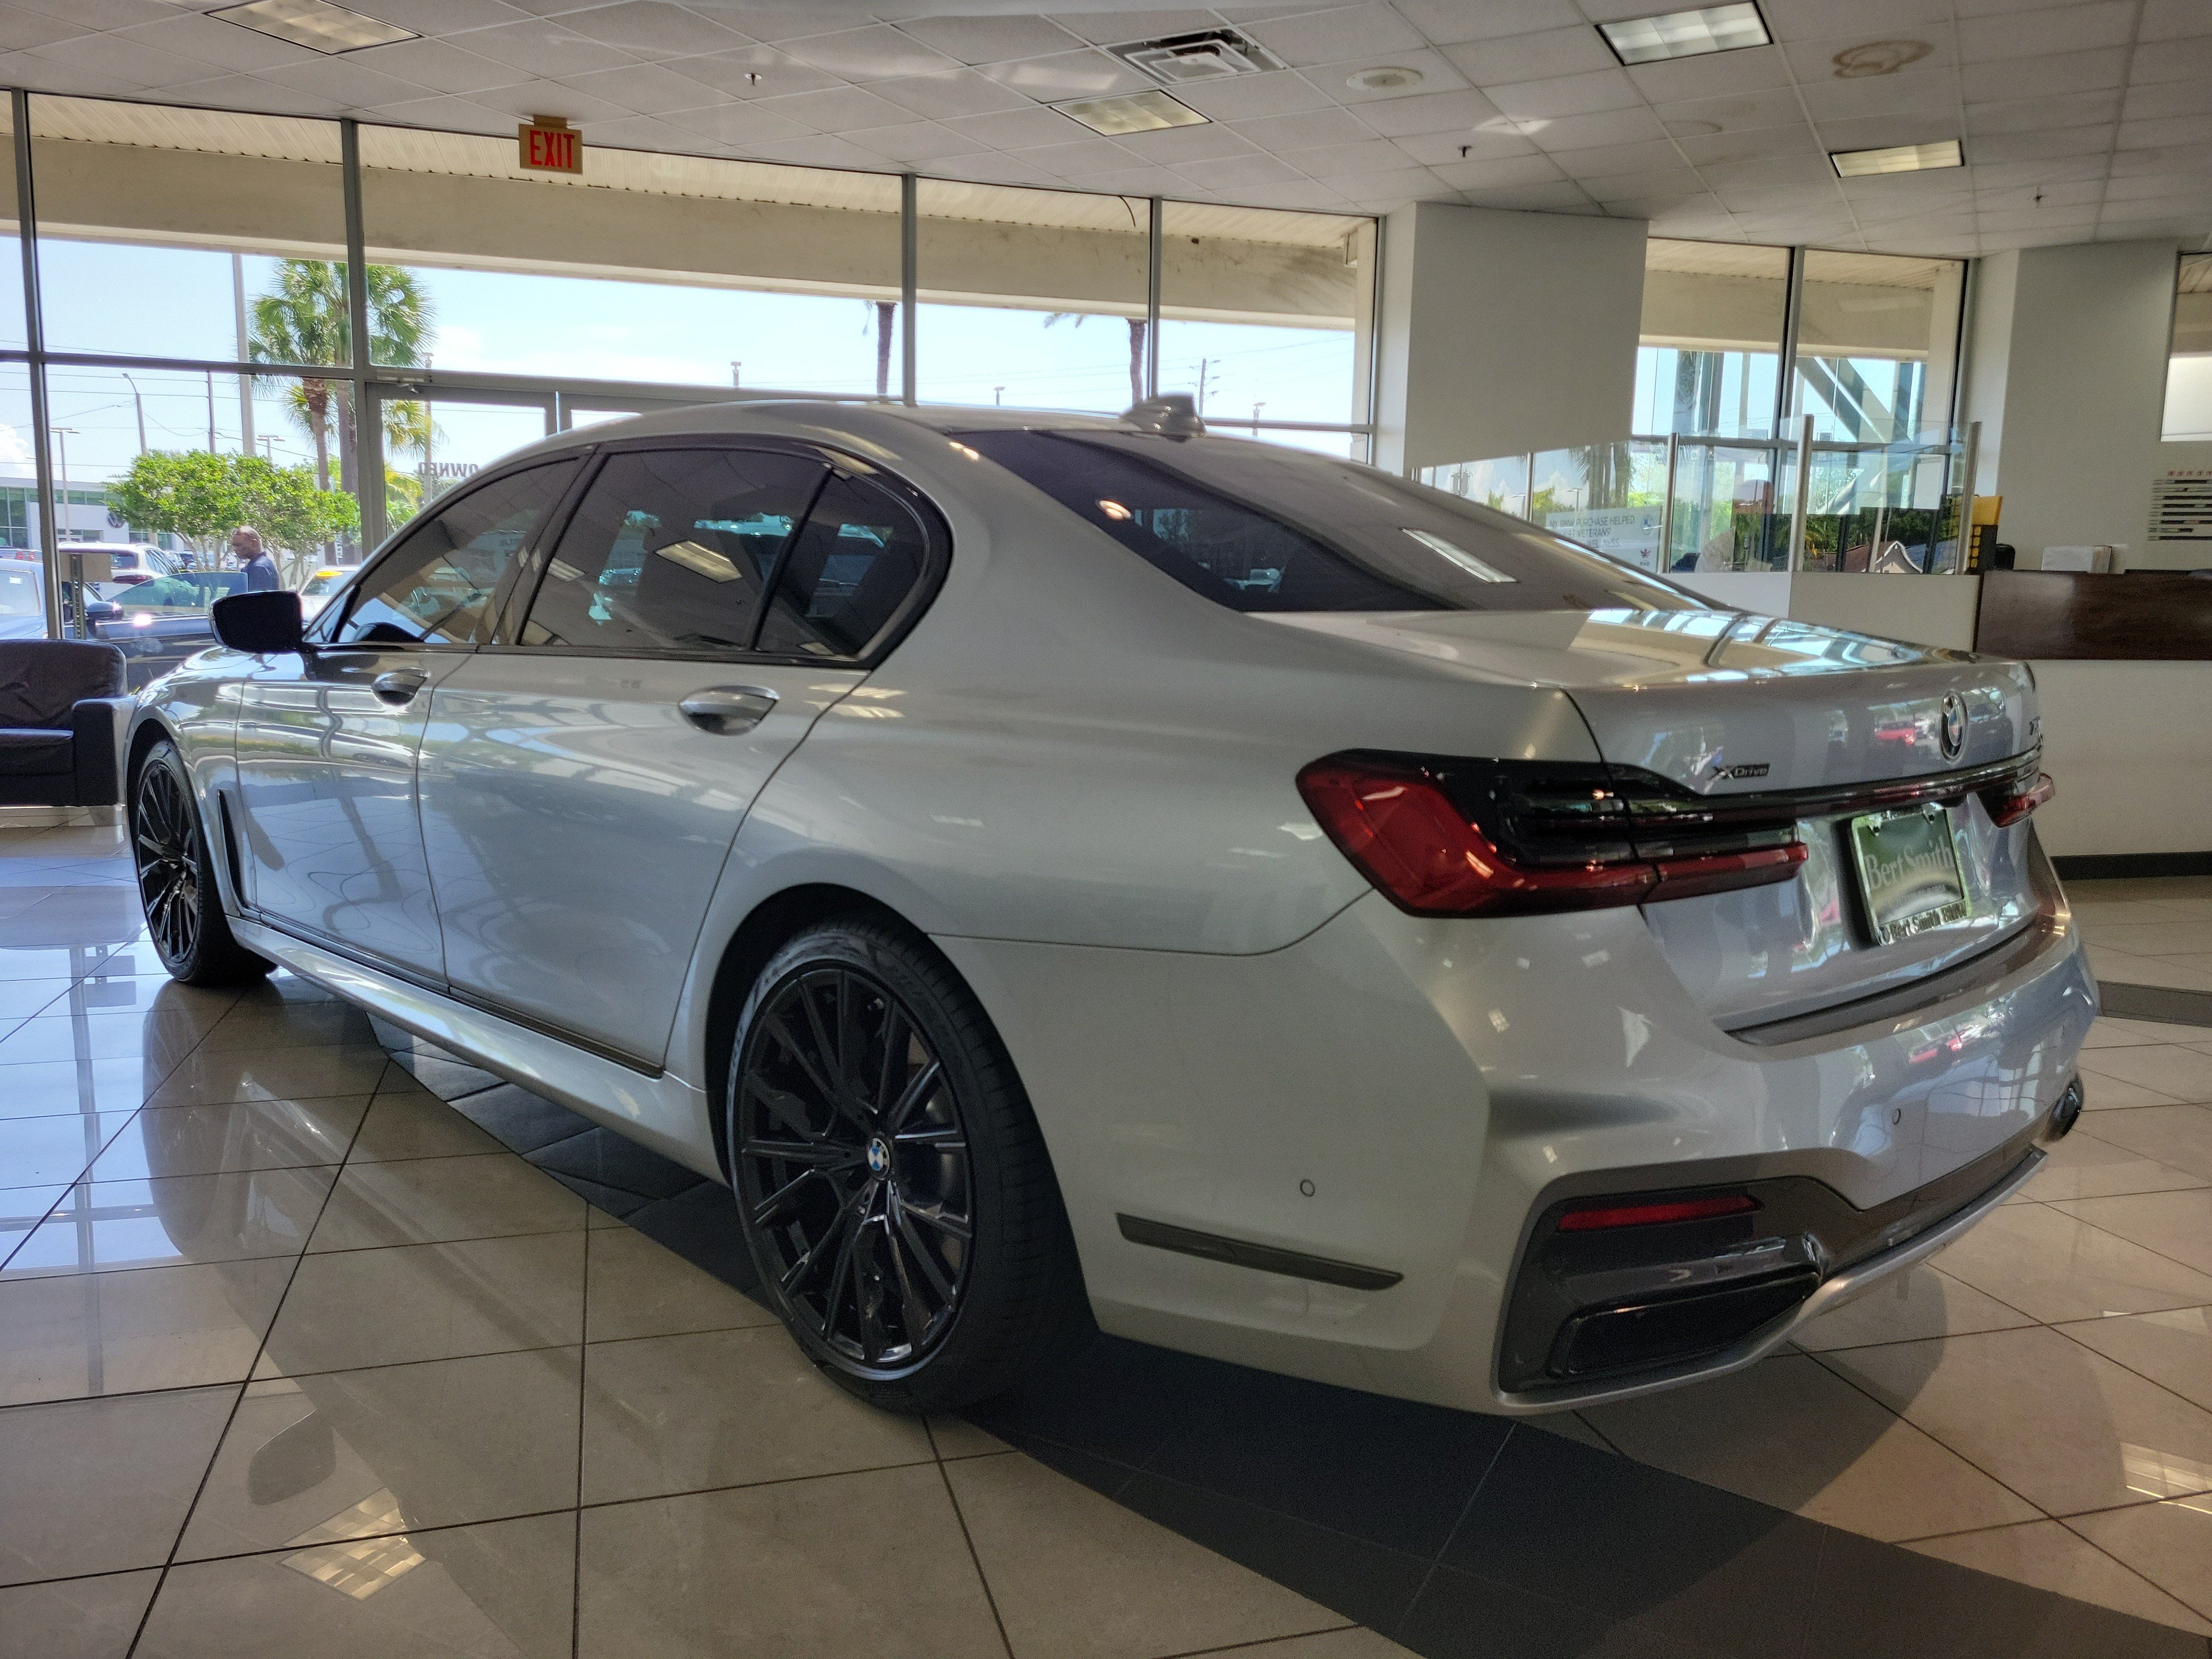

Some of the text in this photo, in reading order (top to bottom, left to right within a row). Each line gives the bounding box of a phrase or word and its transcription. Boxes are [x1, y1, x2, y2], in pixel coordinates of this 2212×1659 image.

[530, 130, 575, 169] EXIT
[1576, 516, 1608, 527] PURCHASE
[1610, 515, 1635, 526] HELPED
[1865, 834, 1954, 889] Bert Smith
[1910, 909, 1940, 934] Smith
